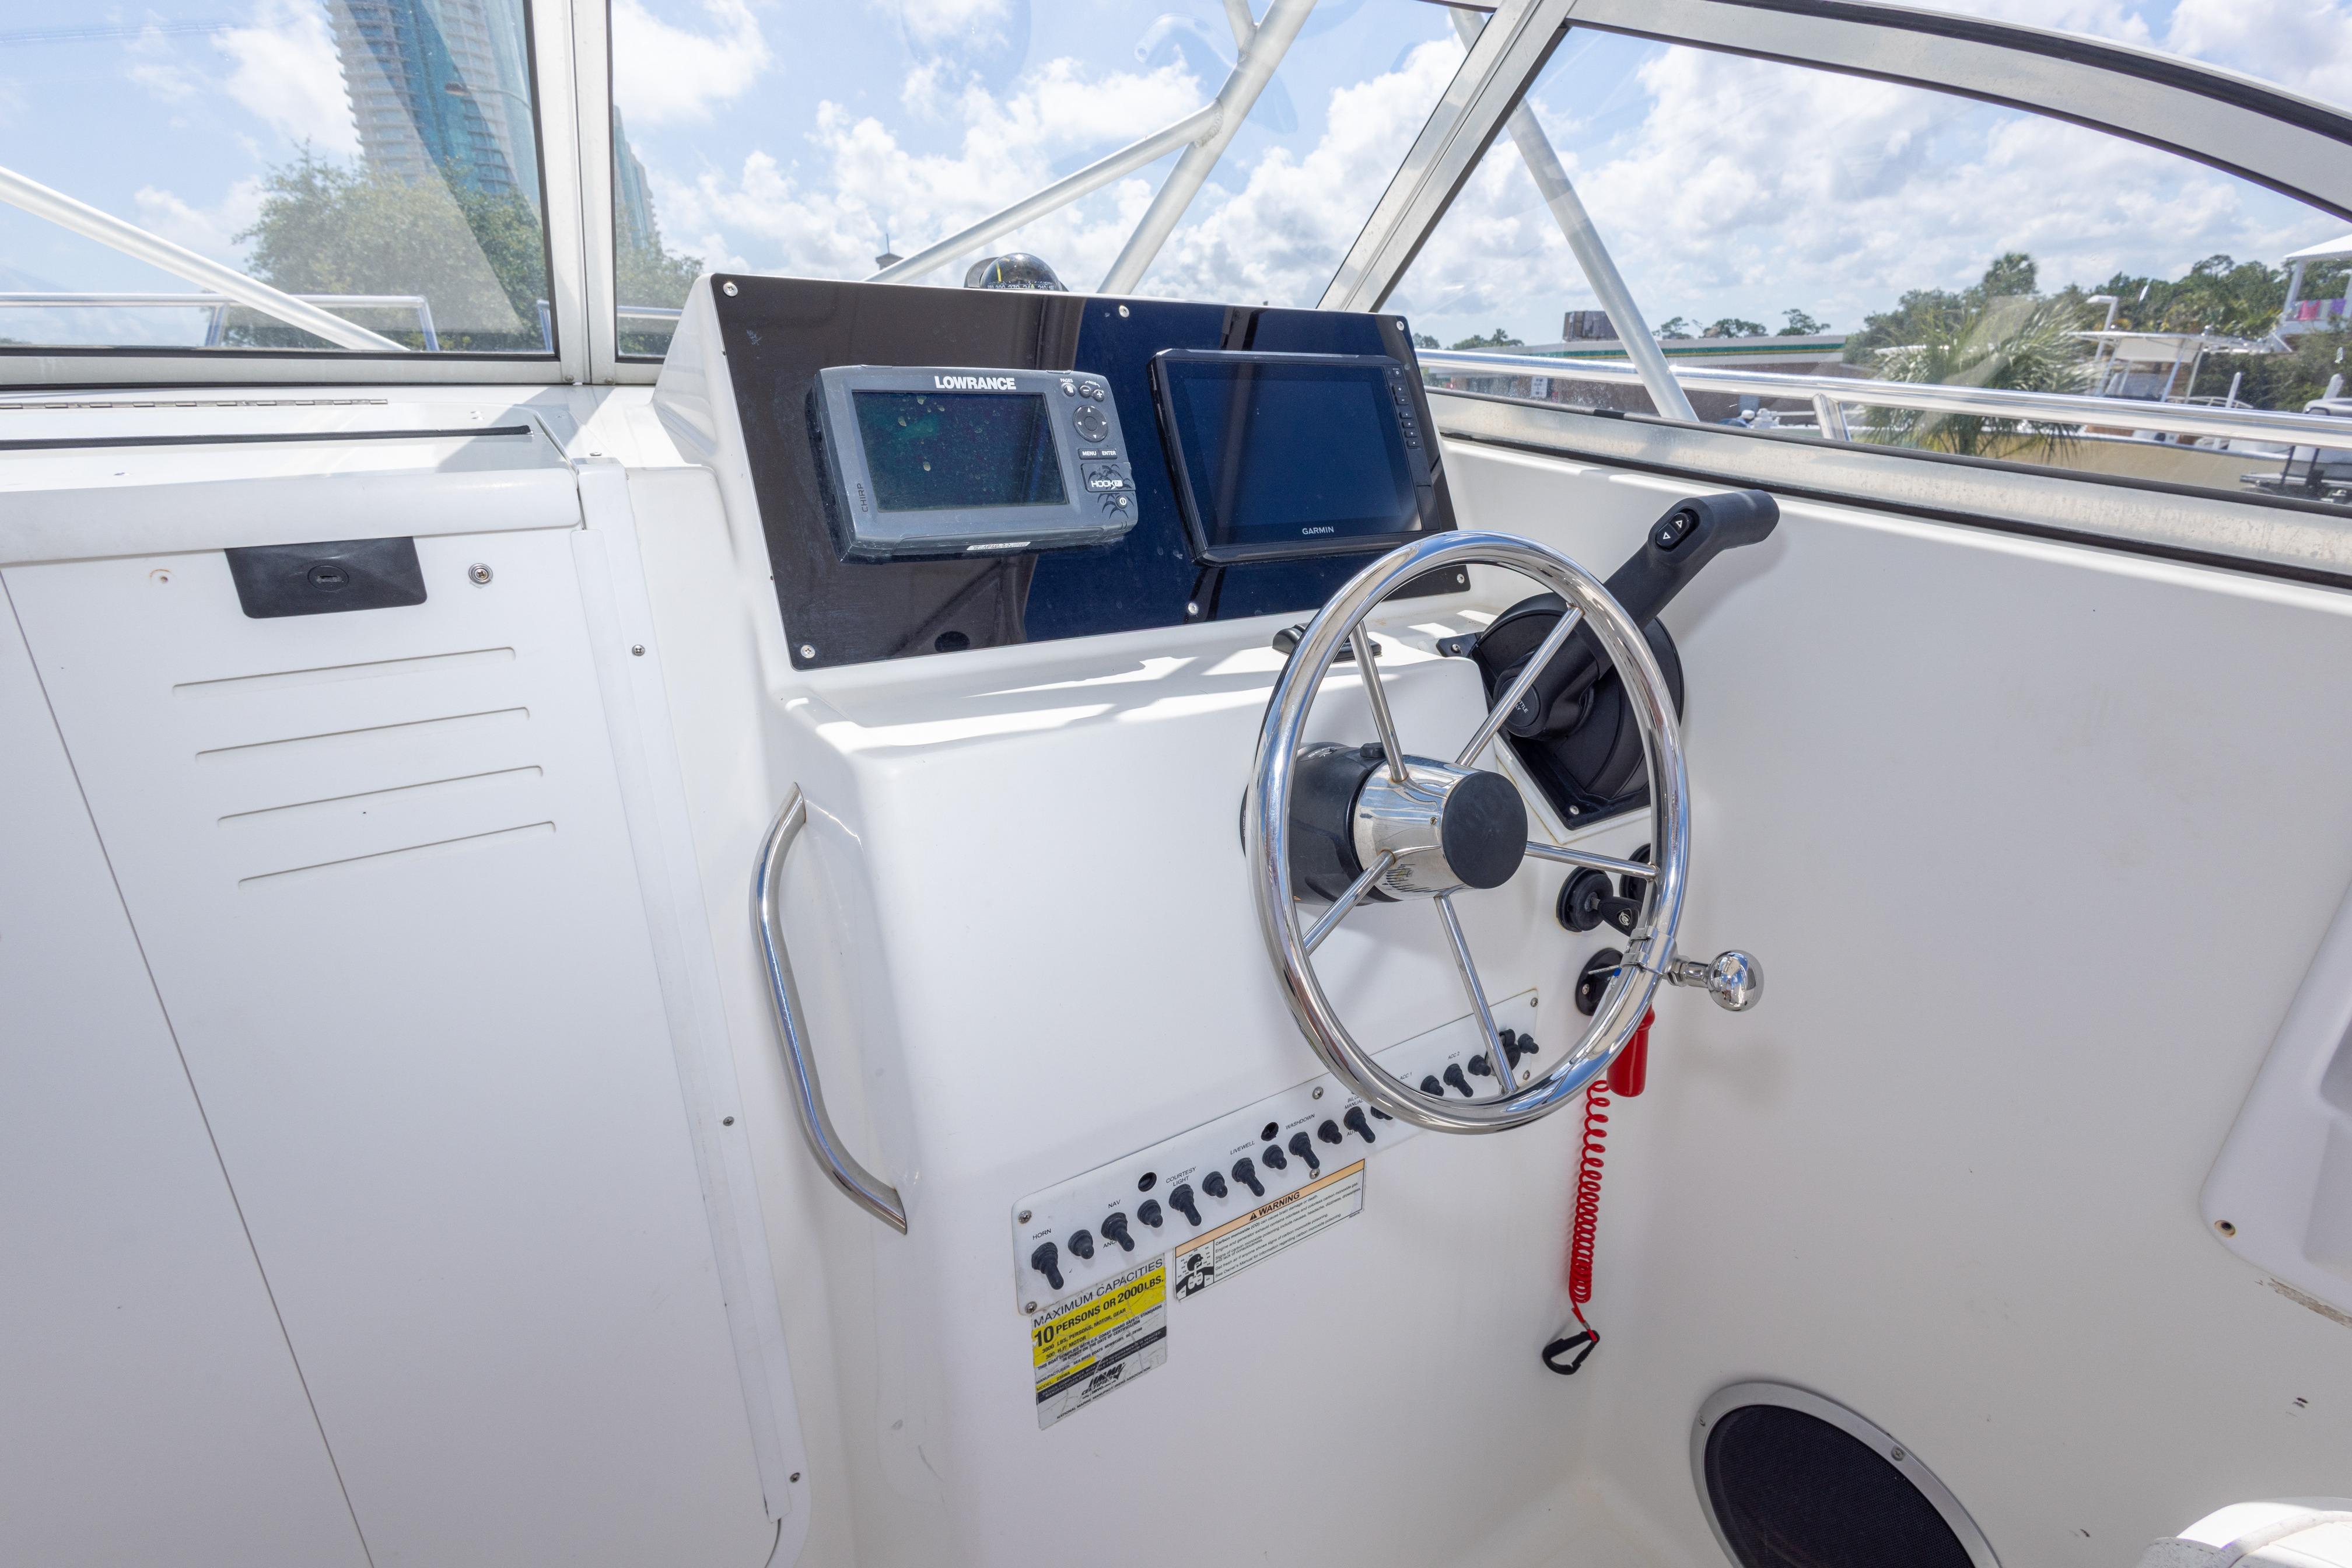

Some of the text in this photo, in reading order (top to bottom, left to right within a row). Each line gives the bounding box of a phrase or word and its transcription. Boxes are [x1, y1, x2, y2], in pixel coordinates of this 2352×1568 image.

[935, 376, 1017, 390] LOWRANCE
[857, 483, 868, 512] CHIRP
[1302, 526, 1334, 534] GARMIN
[1345, 1099, 1363, 1110] MANUAL
[1286, 1114, 1315, 1129] WASHDOWN
[1230, 1140, 1255, 1155] LIVEWELL
[1166, 1166, 1196, 1184] COURTESY
[1172, 1176, 1189, 1186] LIGHT
[1108, 1199, 1121, 1208] NAV
[1259, 1191, 1300, 1216] WARNING
[1032, 1228, 1051, 1240] HORN
[1215, 1236, 1230, 1245] Carbon
[1231, 1226, 1250, 1238] monoxide
[1215, 1244, 1228, 1253] Engine
[1237, 1231, 1254, 1243] generator
[1034, 1258, 1162, 1328] MAXIMUM CAPACITIES
[1034, 1274, 1163, 1349] 10 PERSONS OR 2000 LBS.
[1069, 1324, 1093, 1340] PERSONS,
[1094, 1314, 1111, 1327] MOTOR,
[1113, 1308, 1125, 1317] GEAR
[1048, 1356, 1058, 1365] BOAT
[1059, 1346, 1079, 1359] COMPLIES
[1080, 1340, 1089, 1349] WITH
[1099, 1329, 1111, 1339] COAST
[1112, 1322, 1125, 1332] GUARD
[1140, 1304, 1161, 1318] STANDARDS
[1069, 1335, 1086, 1348] MOTOR
[1097, 1336, 1106, 1344] DATE
